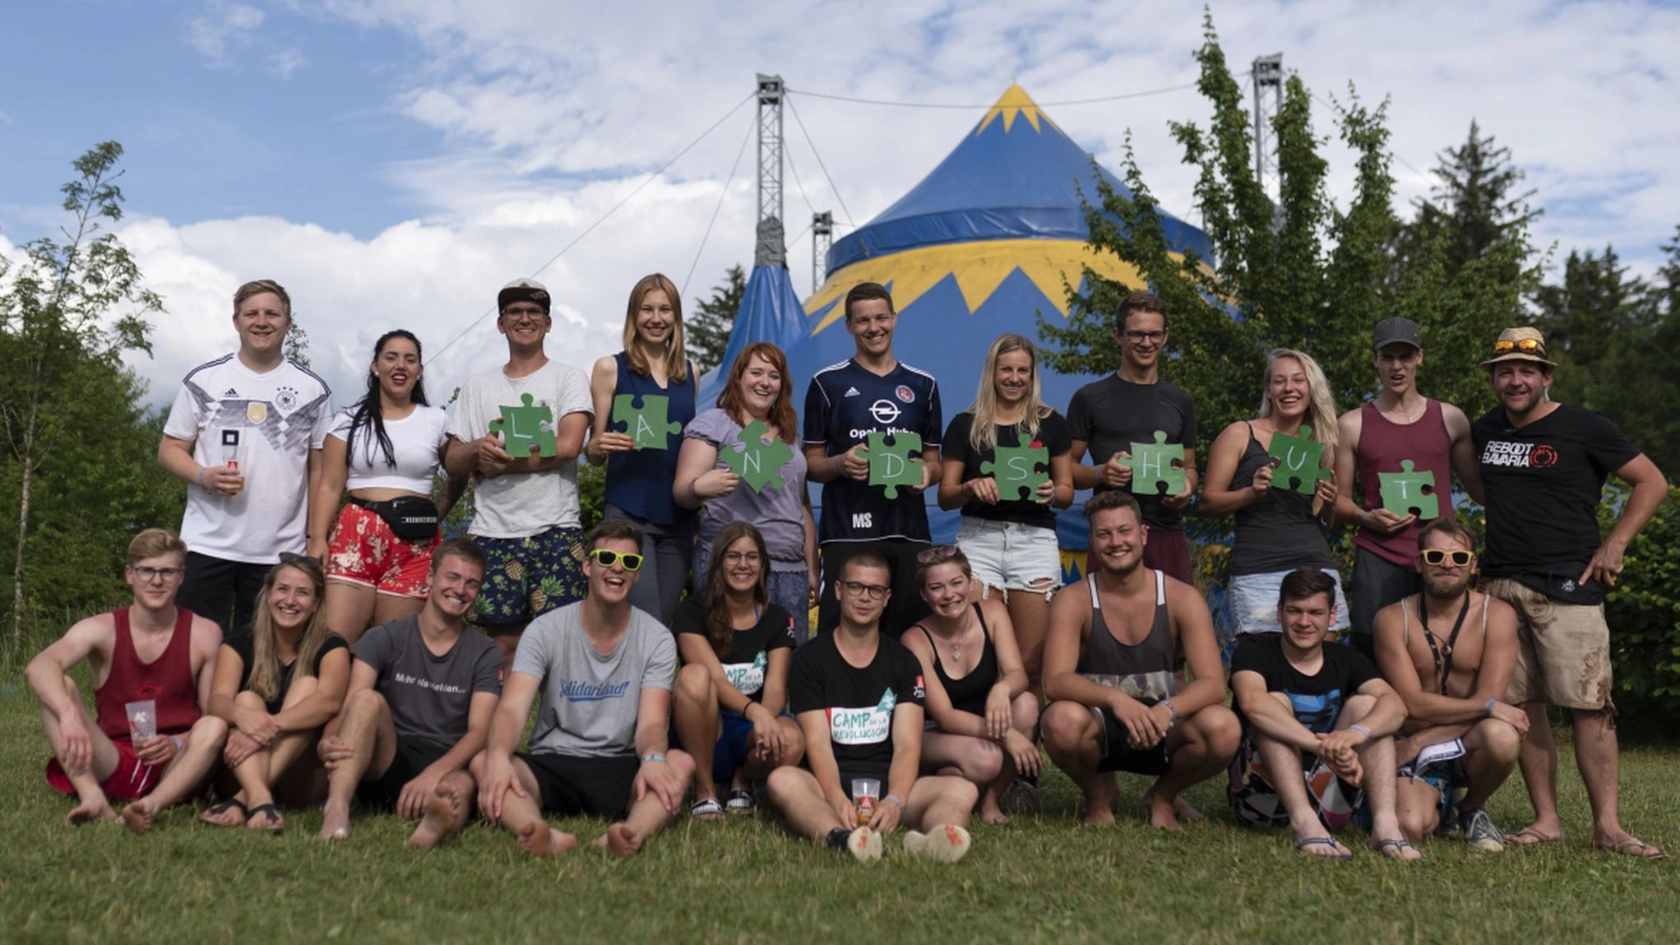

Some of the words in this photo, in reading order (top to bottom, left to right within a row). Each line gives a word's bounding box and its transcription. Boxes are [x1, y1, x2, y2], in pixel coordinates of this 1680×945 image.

[511, 412, 533, 438] L
[636, 414, 655, 442] A
[1287, 445, 1307, 471] U
[1482, 452, 1530, 467] BAVARIA
[1485, 441, 1534, 455] REBOOT
[743, 449, 761, 475] N
[879, 453, 905, 478] D
[1006, 456, 1028, 480] S
[1142, 452, 1161, 478] H
[1393, 479, 1420, 499] T
[852, 512, 872, 529] MS
[833, 712, 871, 729] CAMP
